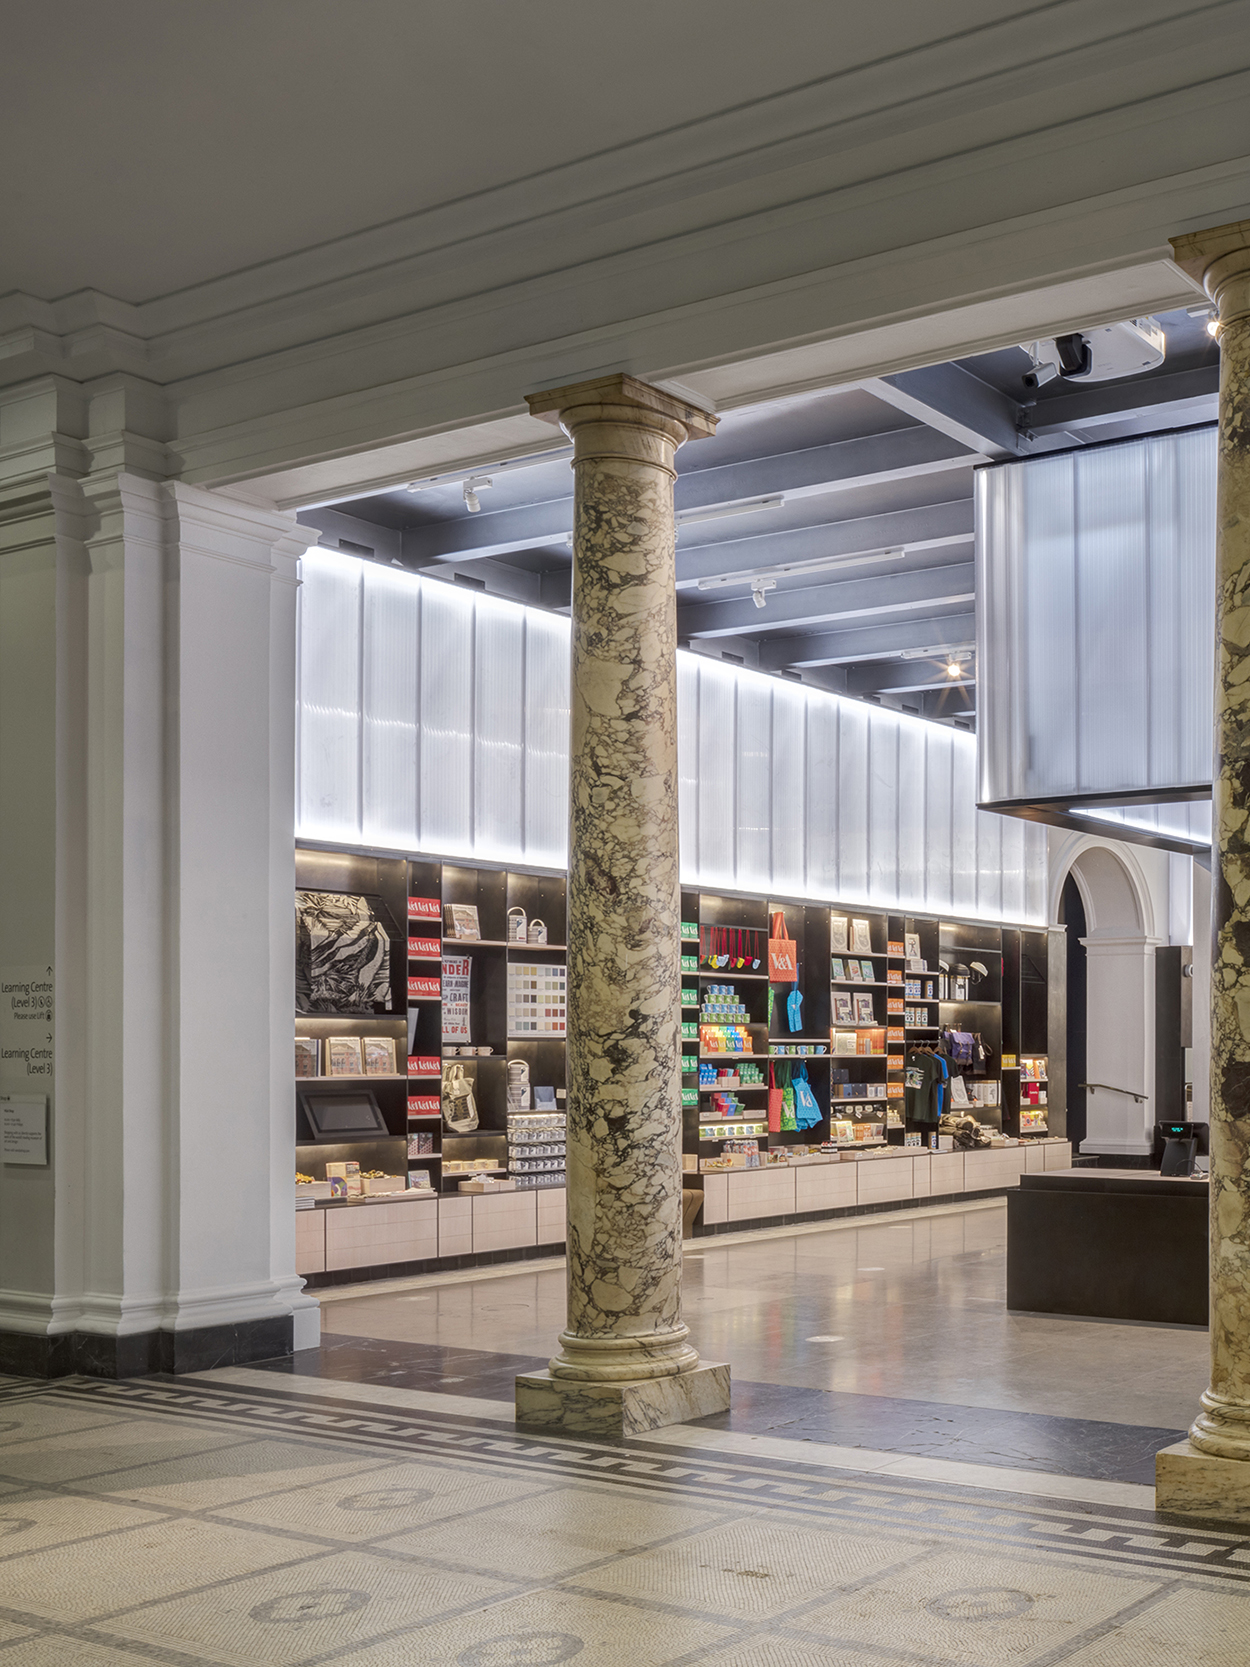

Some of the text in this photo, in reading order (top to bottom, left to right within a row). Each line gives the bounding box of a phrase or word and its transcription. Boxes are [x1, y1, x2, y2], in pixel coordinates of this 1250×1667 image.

[770, 953, 794, 970] V&A
[2, 981, 53, 996] Learning Centre
[11, 996, 38, 1010] (Level 3)
[14, 1012, 28, 1020] Please
[451, 1026, 459, 1034] OF
[460, 1026, 468, 1034] US
[1, 1047, 53, 1062] Learning Centre
[27, 1062, 53, 1076] (Level 3)
